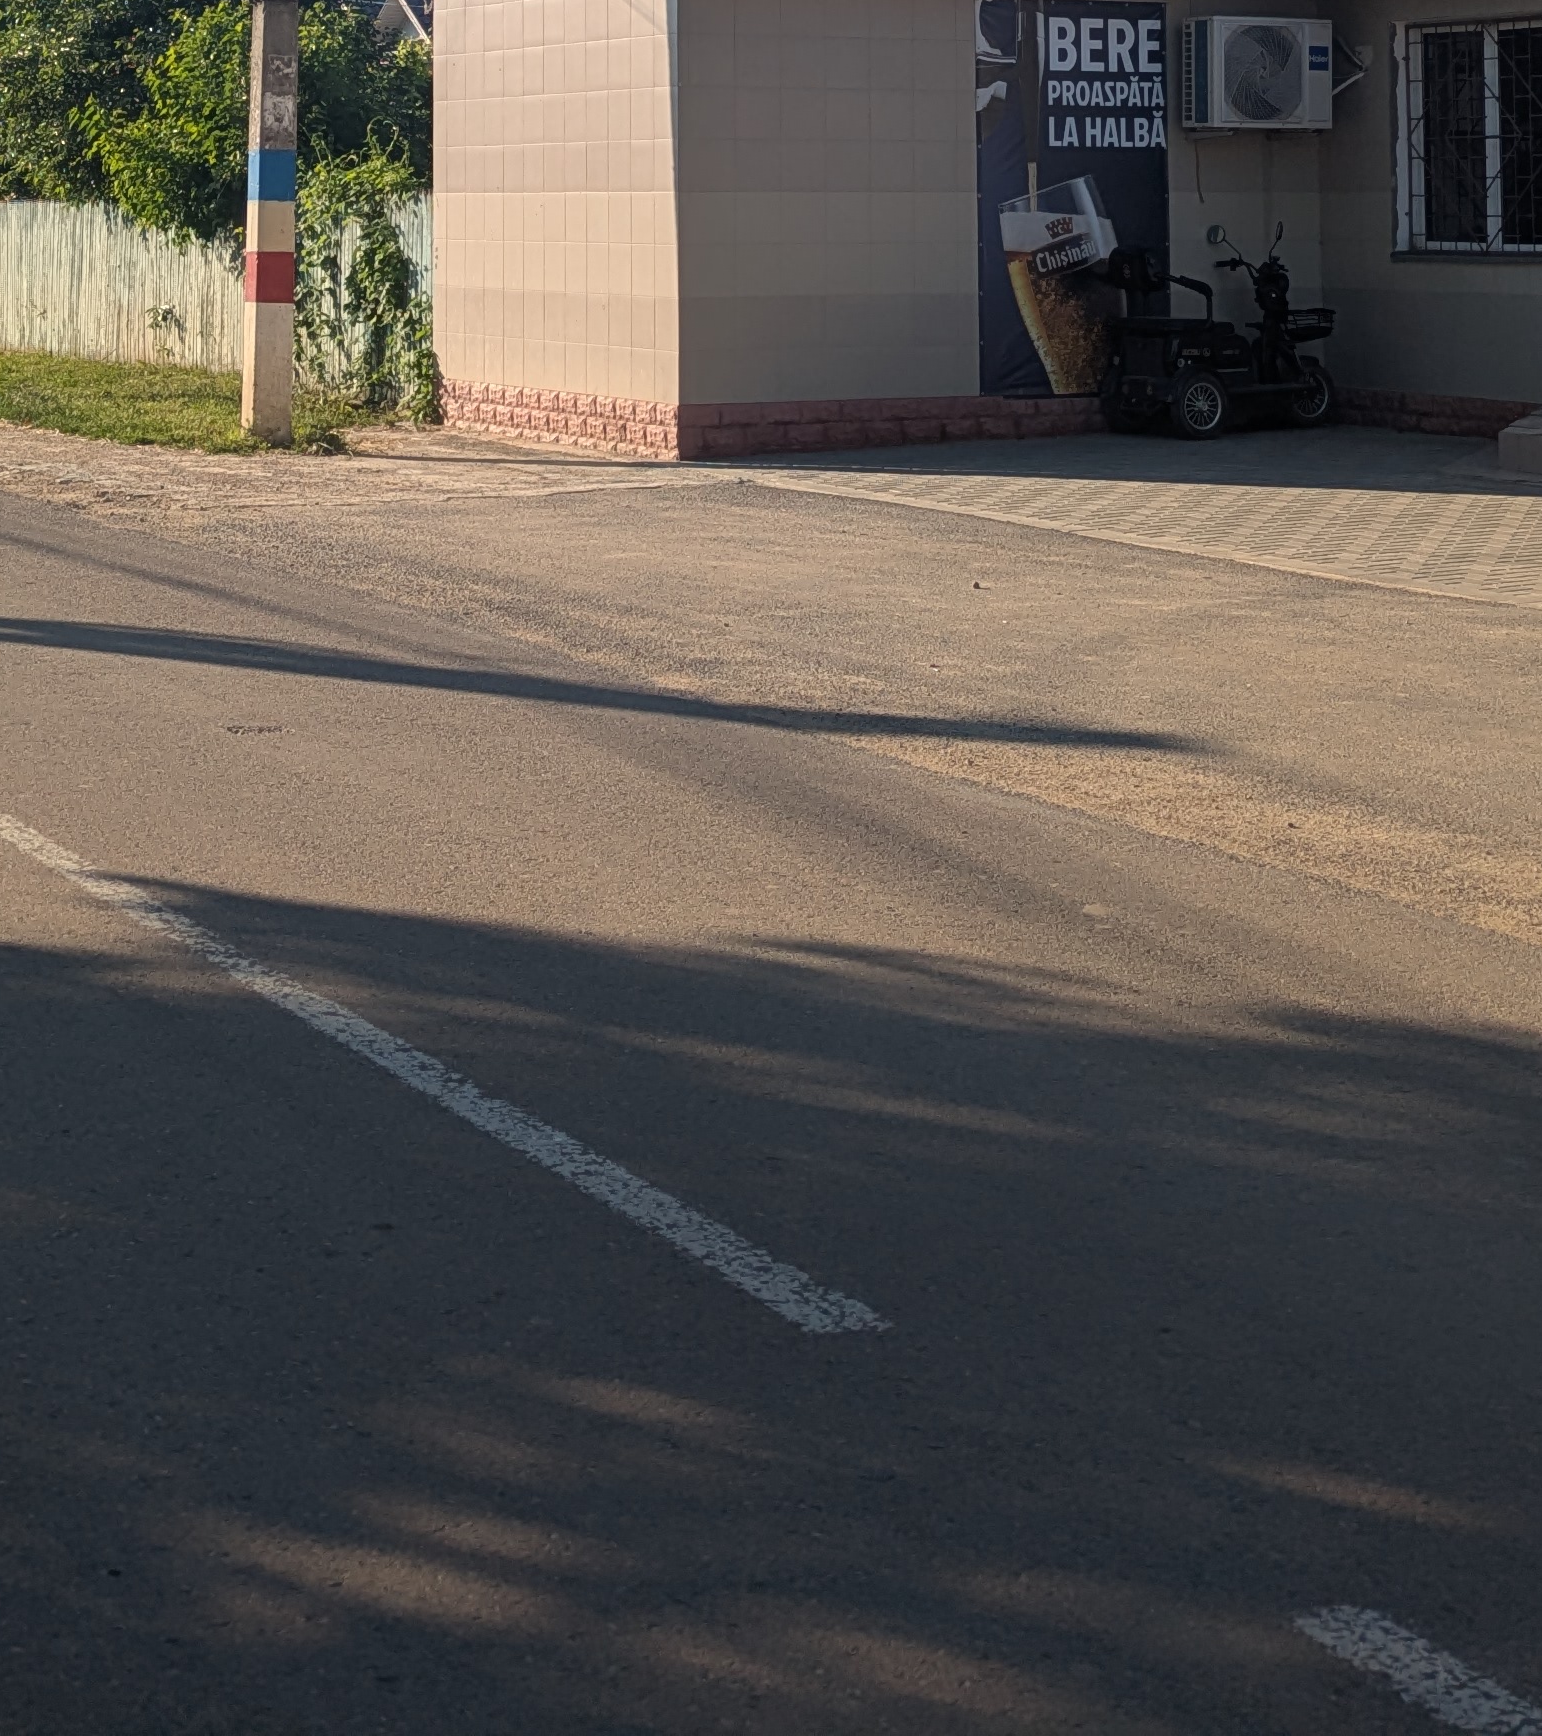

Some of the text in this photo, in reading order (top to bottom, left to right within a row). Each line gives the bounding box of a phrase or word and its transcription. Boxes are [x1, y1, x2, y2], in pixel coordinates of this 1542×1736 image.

[1049, 17, 1162, 72] BERE
[1047, 76, 1165, 107] PROASPĂTĂ
[1049, 110, 1167, 150] LA HALBĂ
